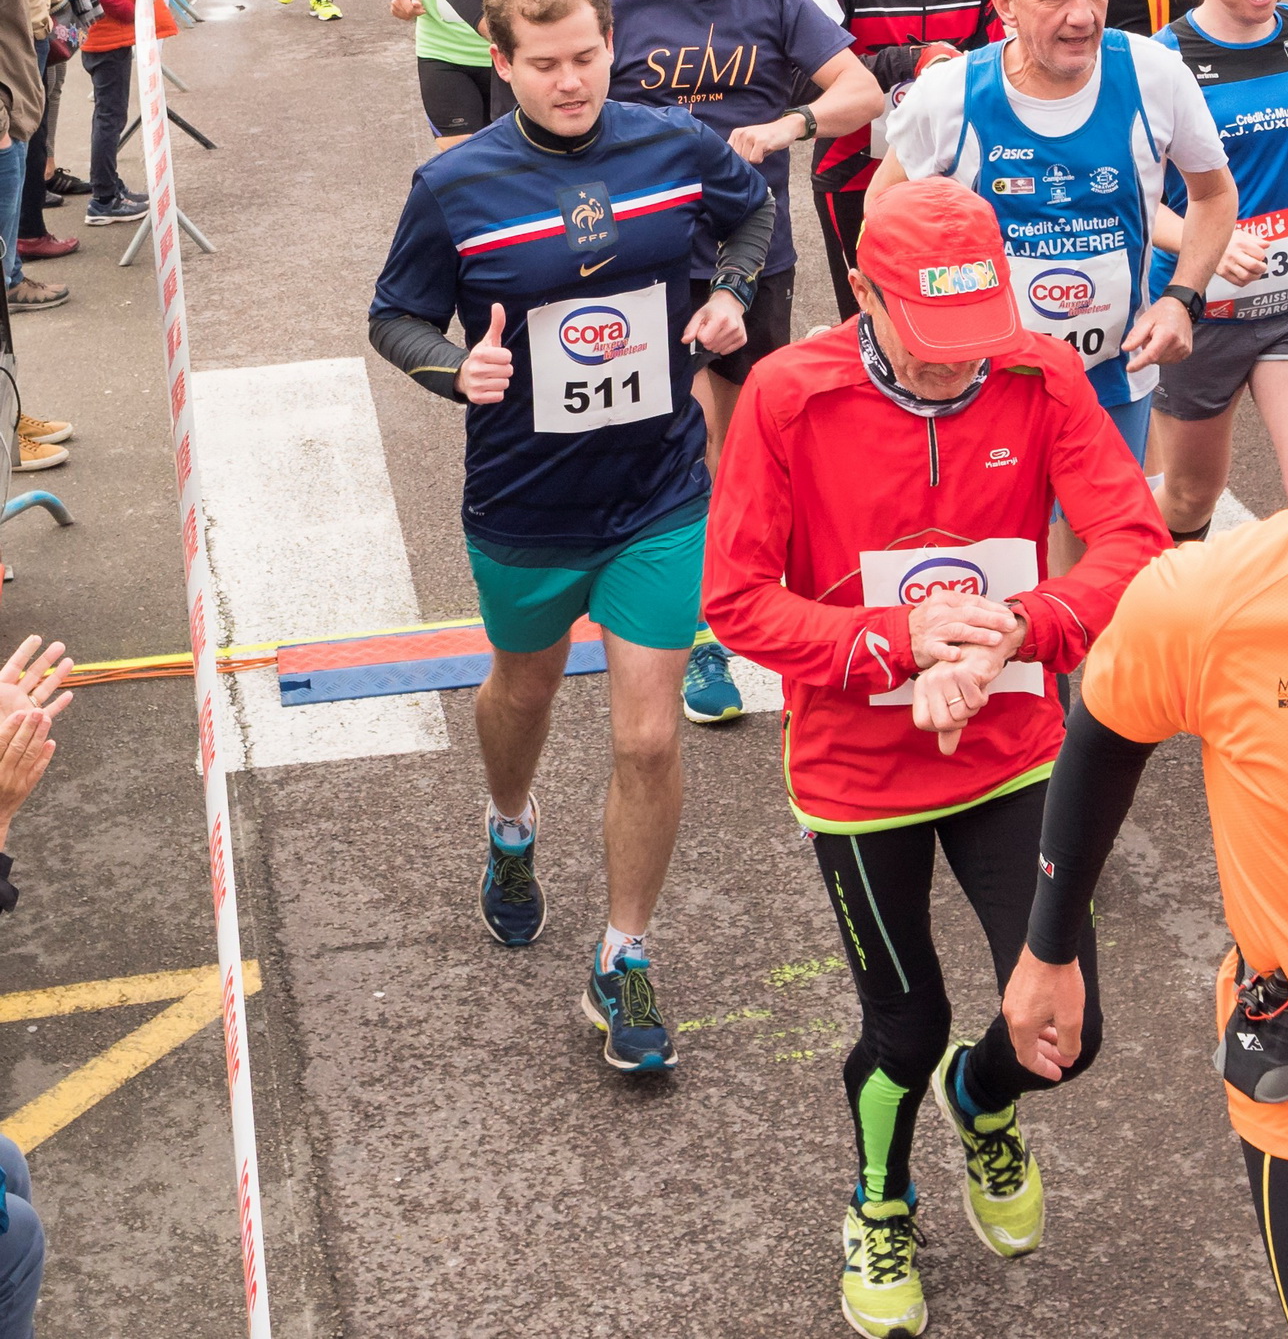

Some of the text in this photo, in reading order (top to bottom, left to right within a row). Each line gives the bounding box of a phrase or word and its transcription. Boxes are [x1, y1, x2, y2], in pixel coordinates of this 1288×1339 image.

[640, 23, 757, 94] SEMI
[677, 92, 723, 105] 21.097 KM
[1236, 115, 1265, 127] Crédit
[1002, 148, 1034, 160] asics
[1007, 216, 1119, 238] Crédit Mutuel
[578, 232, 608, 244] FFF
[927, 260, 997, 294] MASSA
[1032, 284, 1088, 301] cora
[563, 321, 623, 344] cora
[563, 371, 640, 414] 511
[985, 457, 1018, 468] Kalenji
[905, 577, 979, 603] cora
